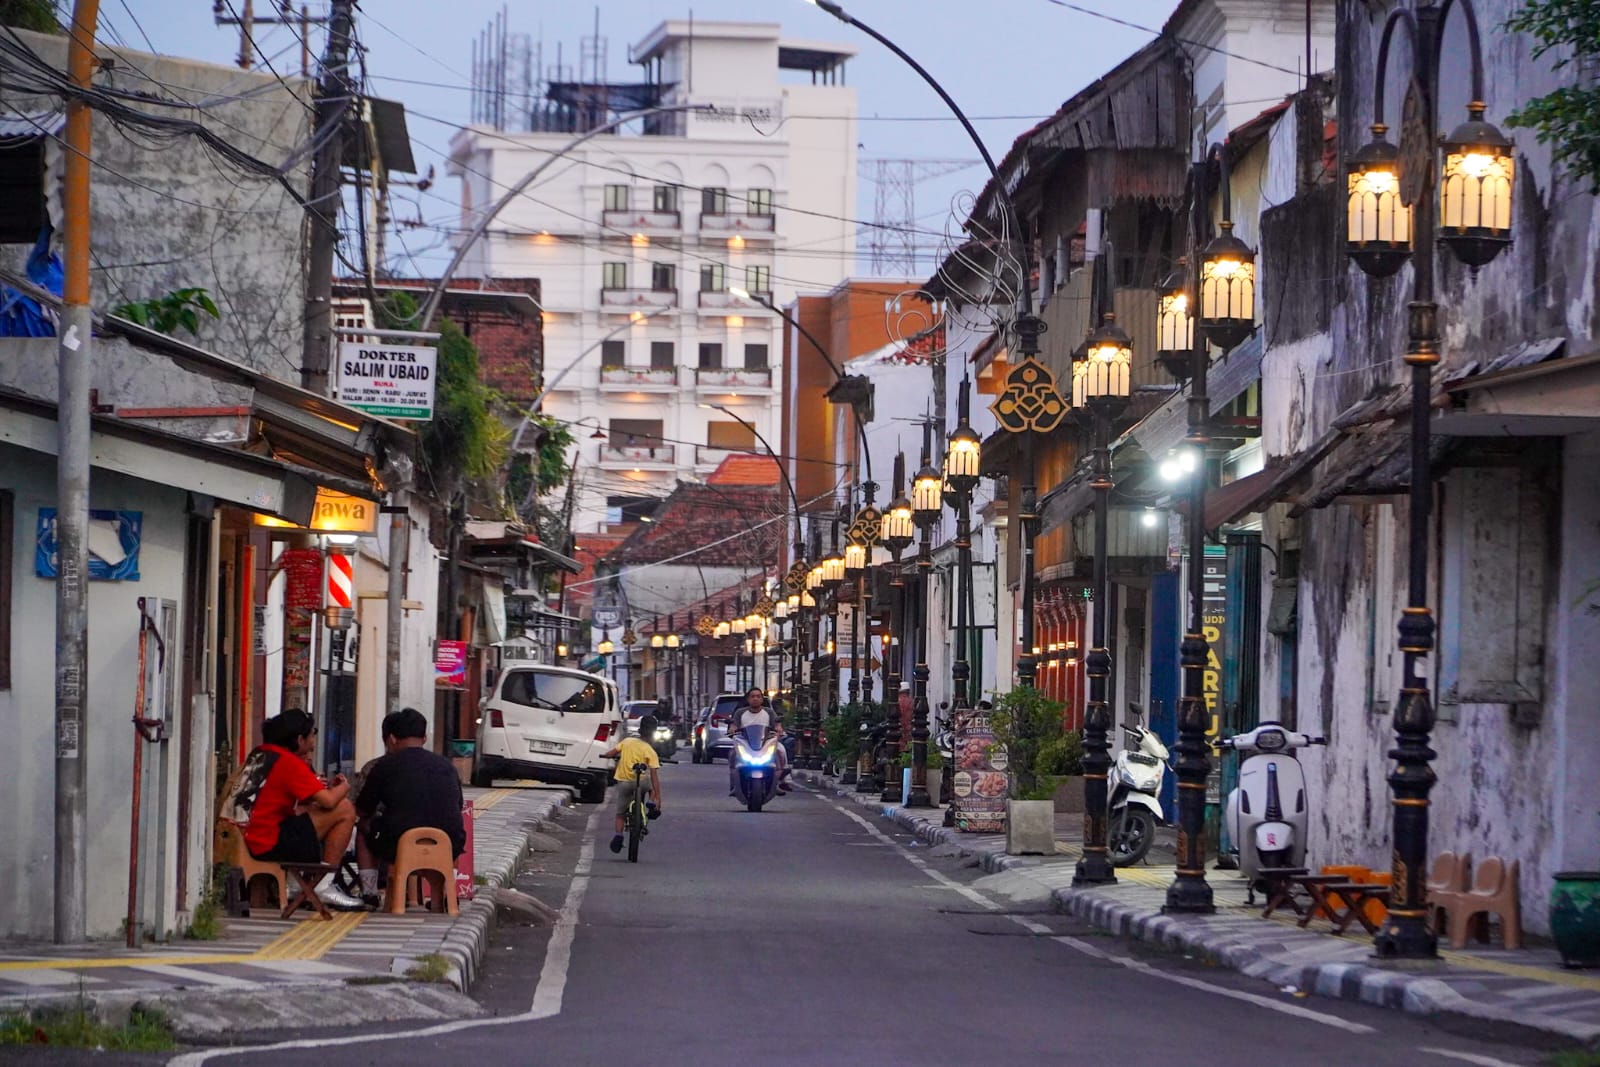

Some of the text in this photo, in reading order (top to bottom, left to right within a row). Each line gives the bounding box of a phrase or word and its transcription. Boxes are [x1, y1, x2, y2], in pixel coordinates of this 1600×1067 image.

[359, 350, 416, 362] DOKTER
[344, 361, 429, 380] SALIM UBAID
